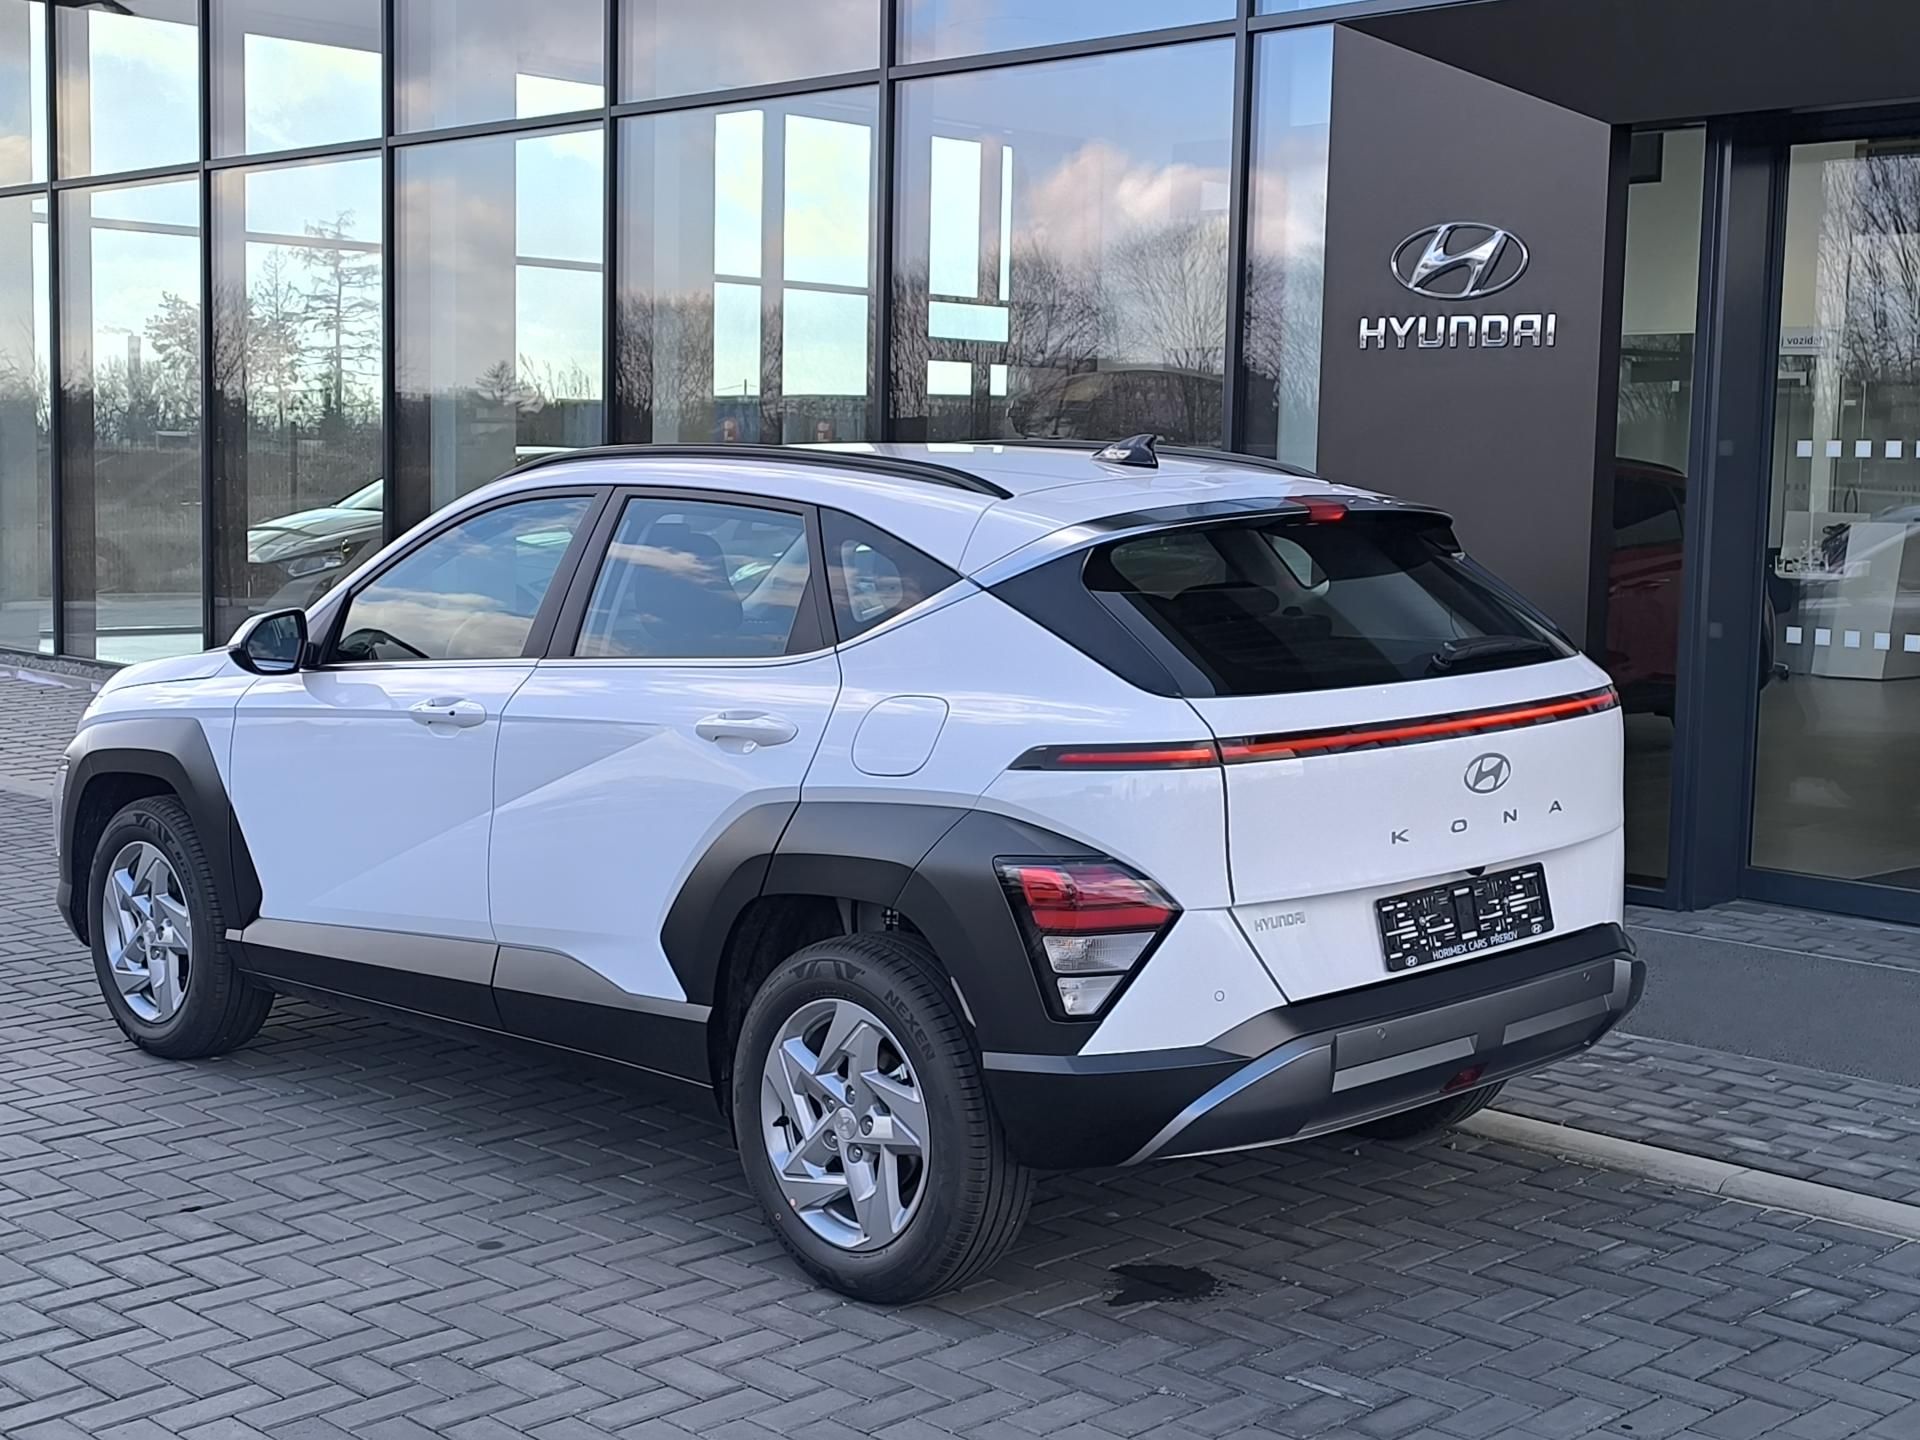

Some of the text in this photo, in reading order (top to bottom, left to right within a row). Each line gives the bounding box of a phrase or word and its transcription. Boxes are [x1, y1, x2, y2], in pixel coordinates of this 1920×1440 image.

[1359, 313, 1557, 349] HYUNDAI
[1391, 800, 1562, 845] KONA
[1254, 911, 1306, 932] HYUNDAI
[1432, 929, 1519, 960] HORIMEX CARS PŘEROV
[884, 989, 937, 1061] NEXEN
